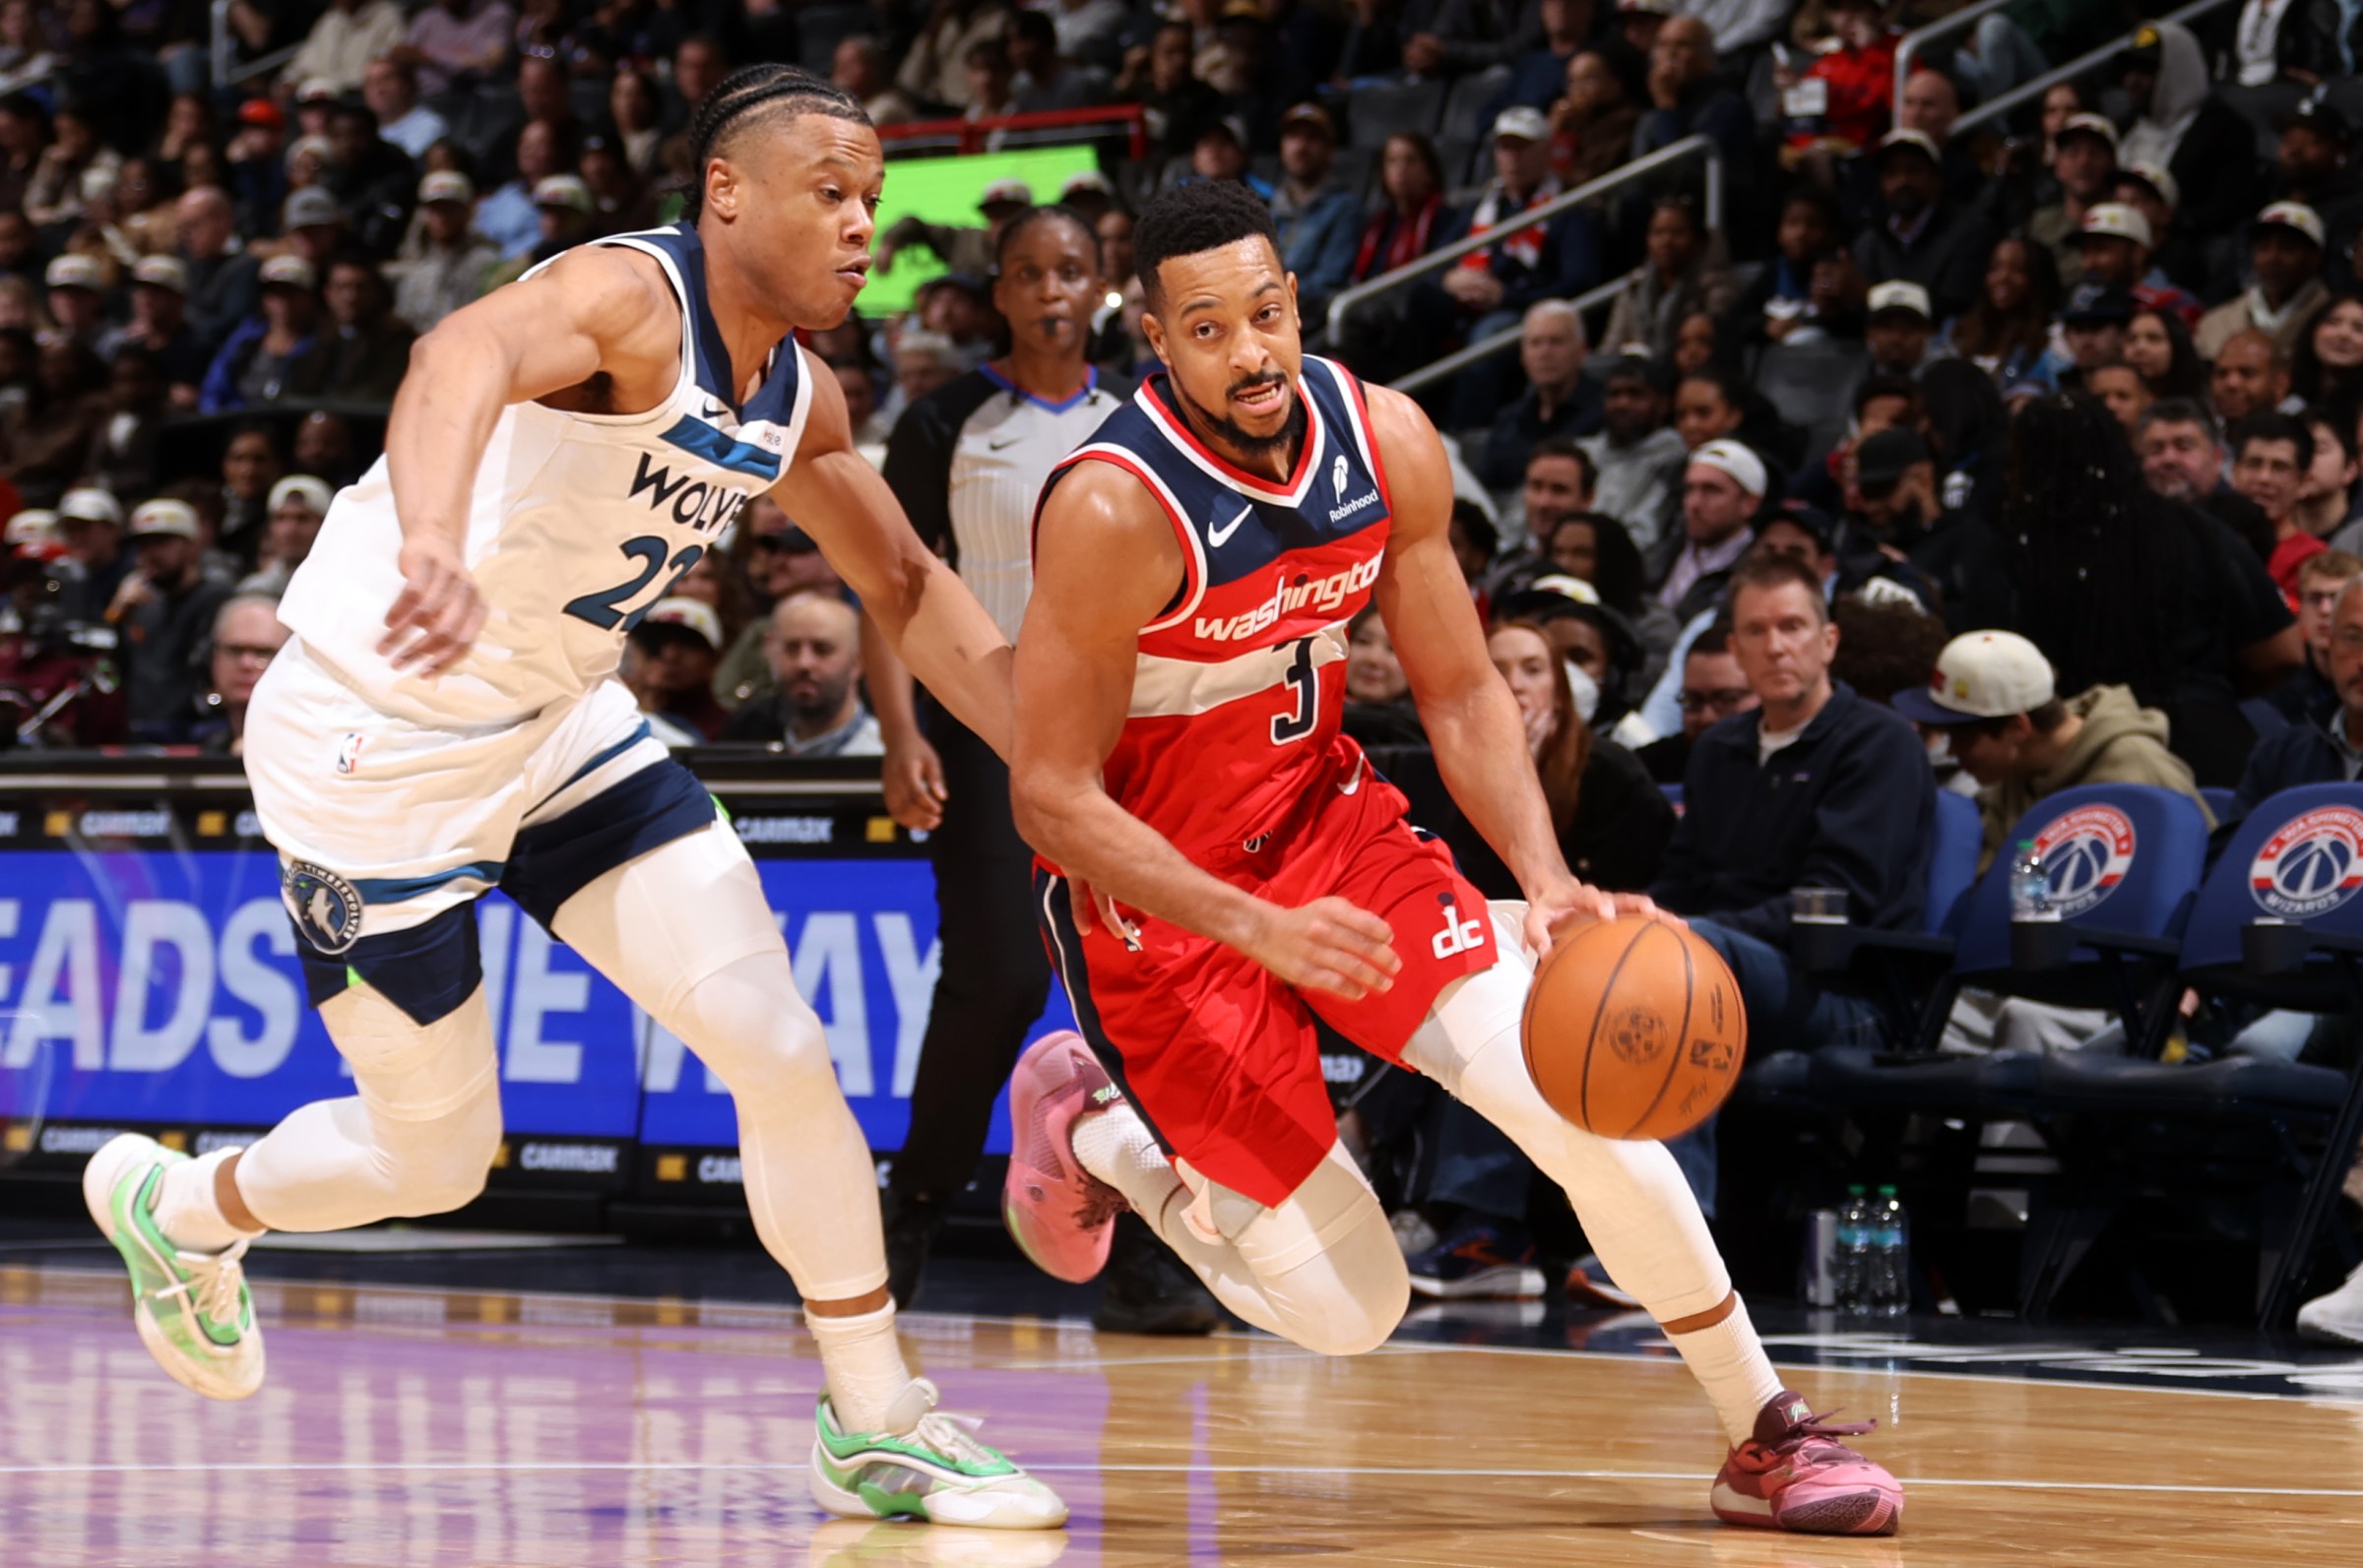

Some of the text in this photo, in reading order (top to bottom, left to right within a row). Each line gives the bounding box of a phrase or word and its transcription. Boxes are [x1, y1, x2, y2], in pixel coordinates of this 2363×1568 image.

[1328, 488, 1379, 523] Robinhood
[1194, 547, 1384, 641] washingto
[1271, 636, 1319, 745] 3
[305, 863, 359, 941] TIMBERWOLVES
[1432, 892, 1485, 960] dc
[2267, 893, 2340, 914] WIZARDS
[0, 898, 301, 1079] ADS
